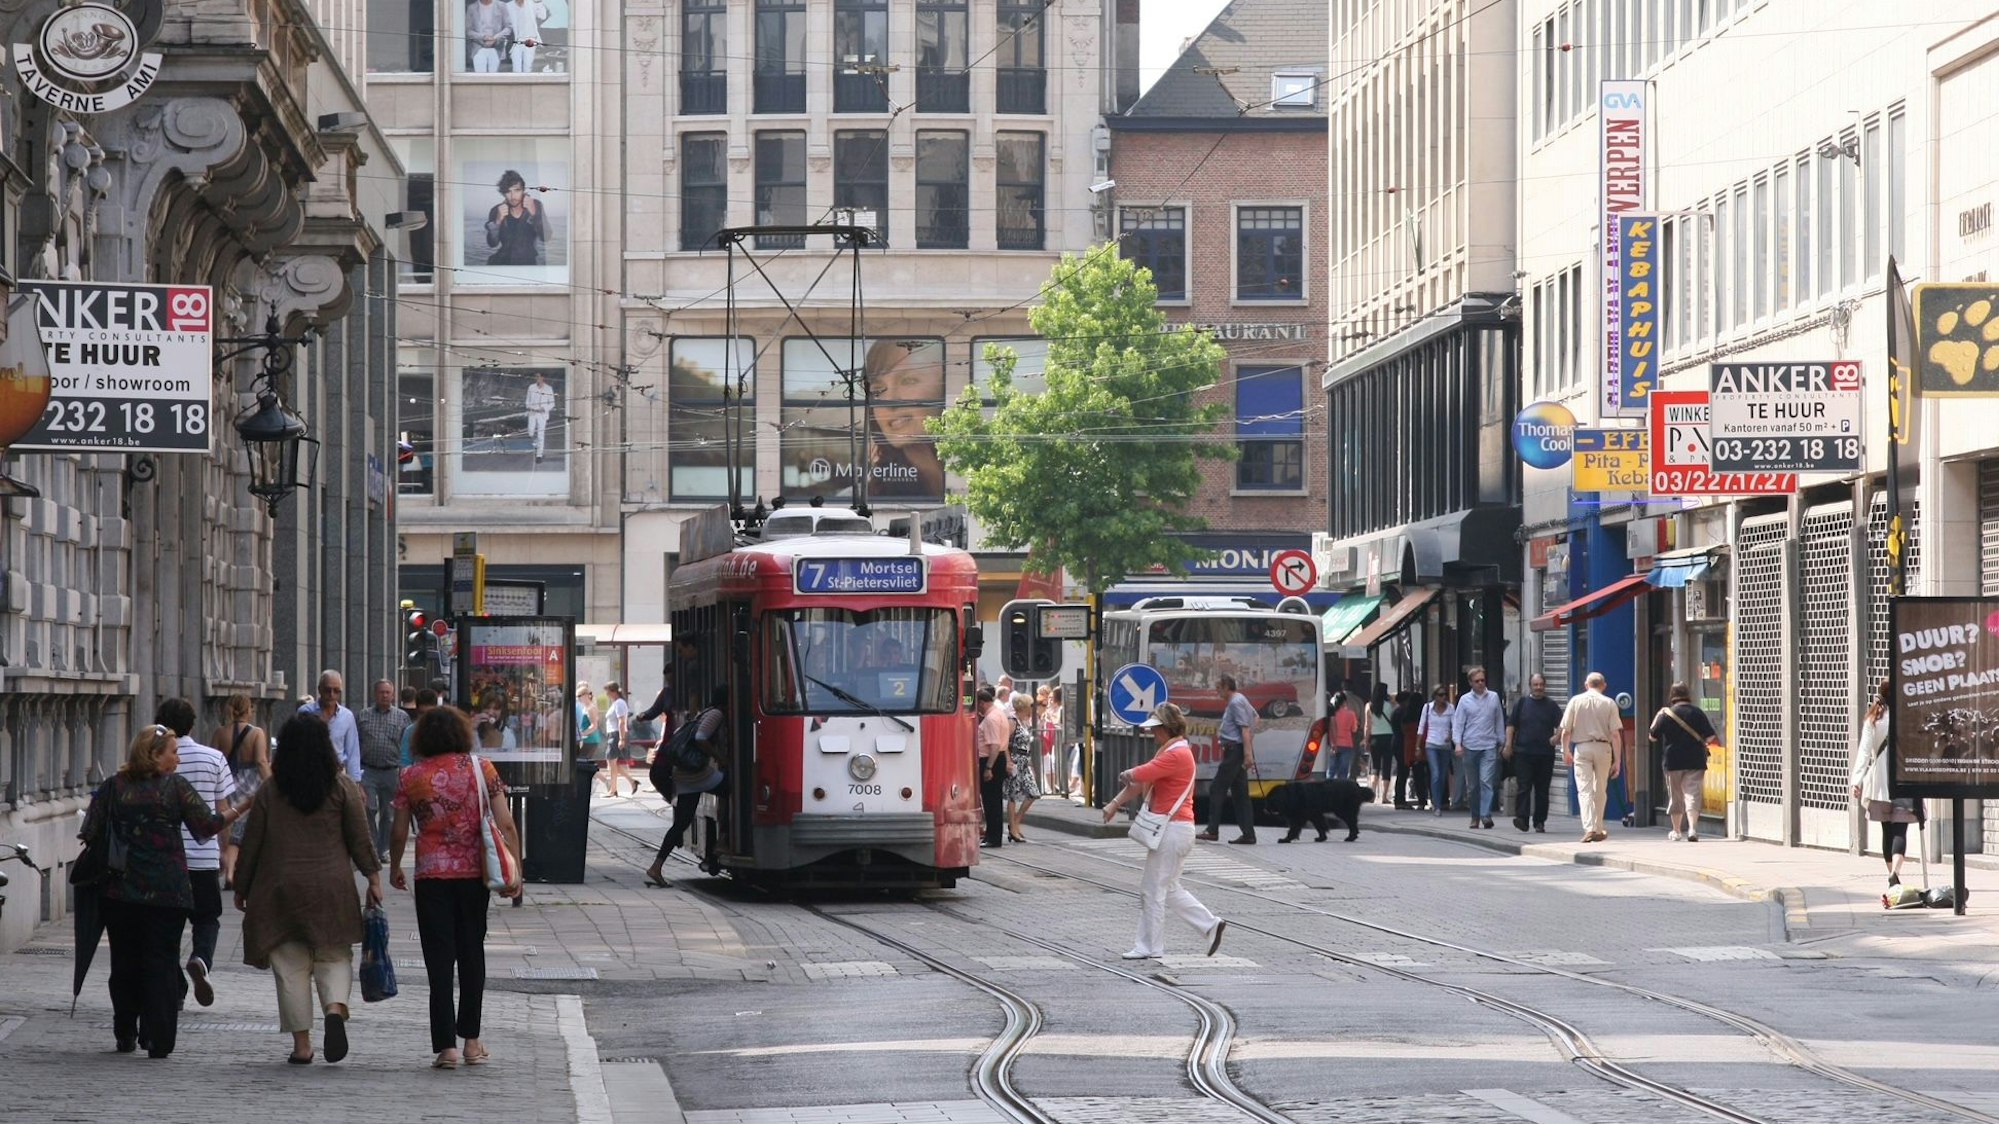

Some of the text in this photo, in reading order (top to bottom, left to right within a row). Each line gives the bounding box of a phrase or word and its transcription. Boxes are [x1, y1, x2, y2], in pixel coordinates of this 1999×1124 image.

[16, 53, 157, 112] TAVERNE AMI
[33, 288, 207, 333] NKER 18
[1628, 221, 1653, 398] KEBAPHUIS
[89, 332, 206, 344] CONSULTANTS
[81, 344, 161, 367] HUUR
[96, 375, 191, 392] showroom
[1715, 364, 1859, 393] ANKER 18
[120, 402, 156, 434] 18
[170, 403, 206, 435] 18
[1747, 402, 1826, 419] TE HUUR
[1724, 423, 1768, 432] Kantoren
[1770, 423, 1797, 432] vanaf
[1799, 422, 1812, 432] 50
[51, 436, 141, 447] www.anker18.be
[1715, 439, 1792, 461] 03-232
[1800, 439, 1825, 460] 18
[1834, 438, 1859, 460] 18
[1584, 453, 1621, 469] Pita
[807, 561, 918, 589] 7 Mortsel
[827, 576, 918, 589] St.-Pietersvliet
[1264, 629, 1287, 638] 4397
[1899, 622, 1980, 654] DUUR?
[548, 650, 559, 661] A
[1901, 651, 1967, 677] SNOB?
[893, 681, 905, 696] 2
[1903, 677, 1946, 697] GEEN
[848, 784, 882, 796] 7008
